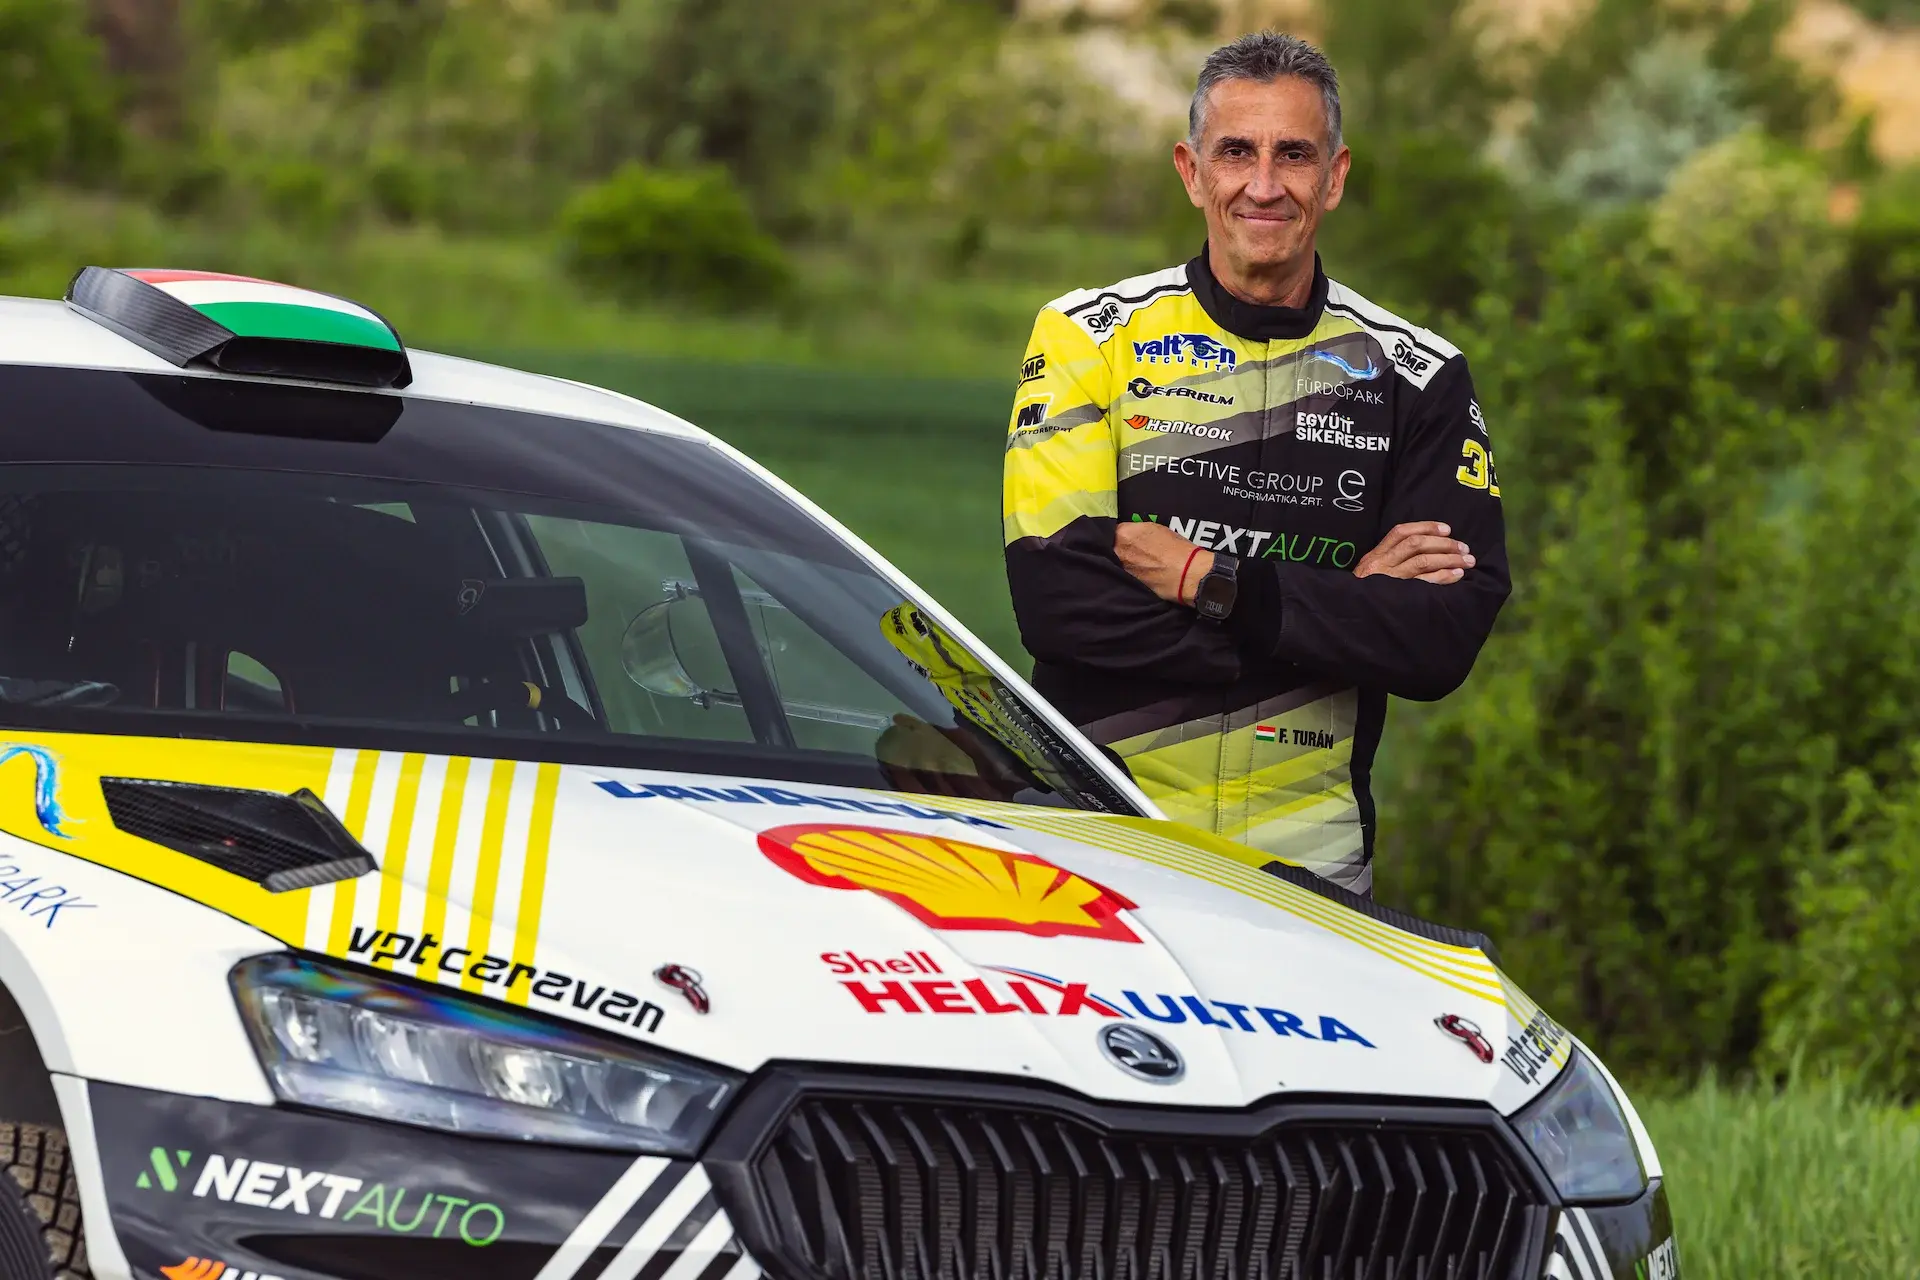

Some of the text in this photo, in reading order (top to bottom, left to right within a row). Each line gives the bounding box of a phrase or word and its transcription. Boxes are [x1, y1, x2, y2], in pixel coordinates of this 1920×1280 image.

[1086, 303, 1120, 329] OMP
[1019, 358, 1045, 380] MP
[1136, 356, 1235, 372] SECURITY
[1394, 343, 1429, 373] OMP
[1297, 379, 1384, 404] FÜRDŐPARK
[1297, 412, 1354, 434] EGYÜTT
[1130, 453, 1323, 493] EFFECTIVE GROUP
[1300, 496, 1323, 507] ZRT.
[1278, 728, 1334, 750] F. TURÁN
[820, 950, 942, 976] Shell
[438, 947, 665, 1033] caravan
[838, 977, 1377, 1048] HELIX ULTRA
[192, 1153, 505, 1247] NEXTAUTO
